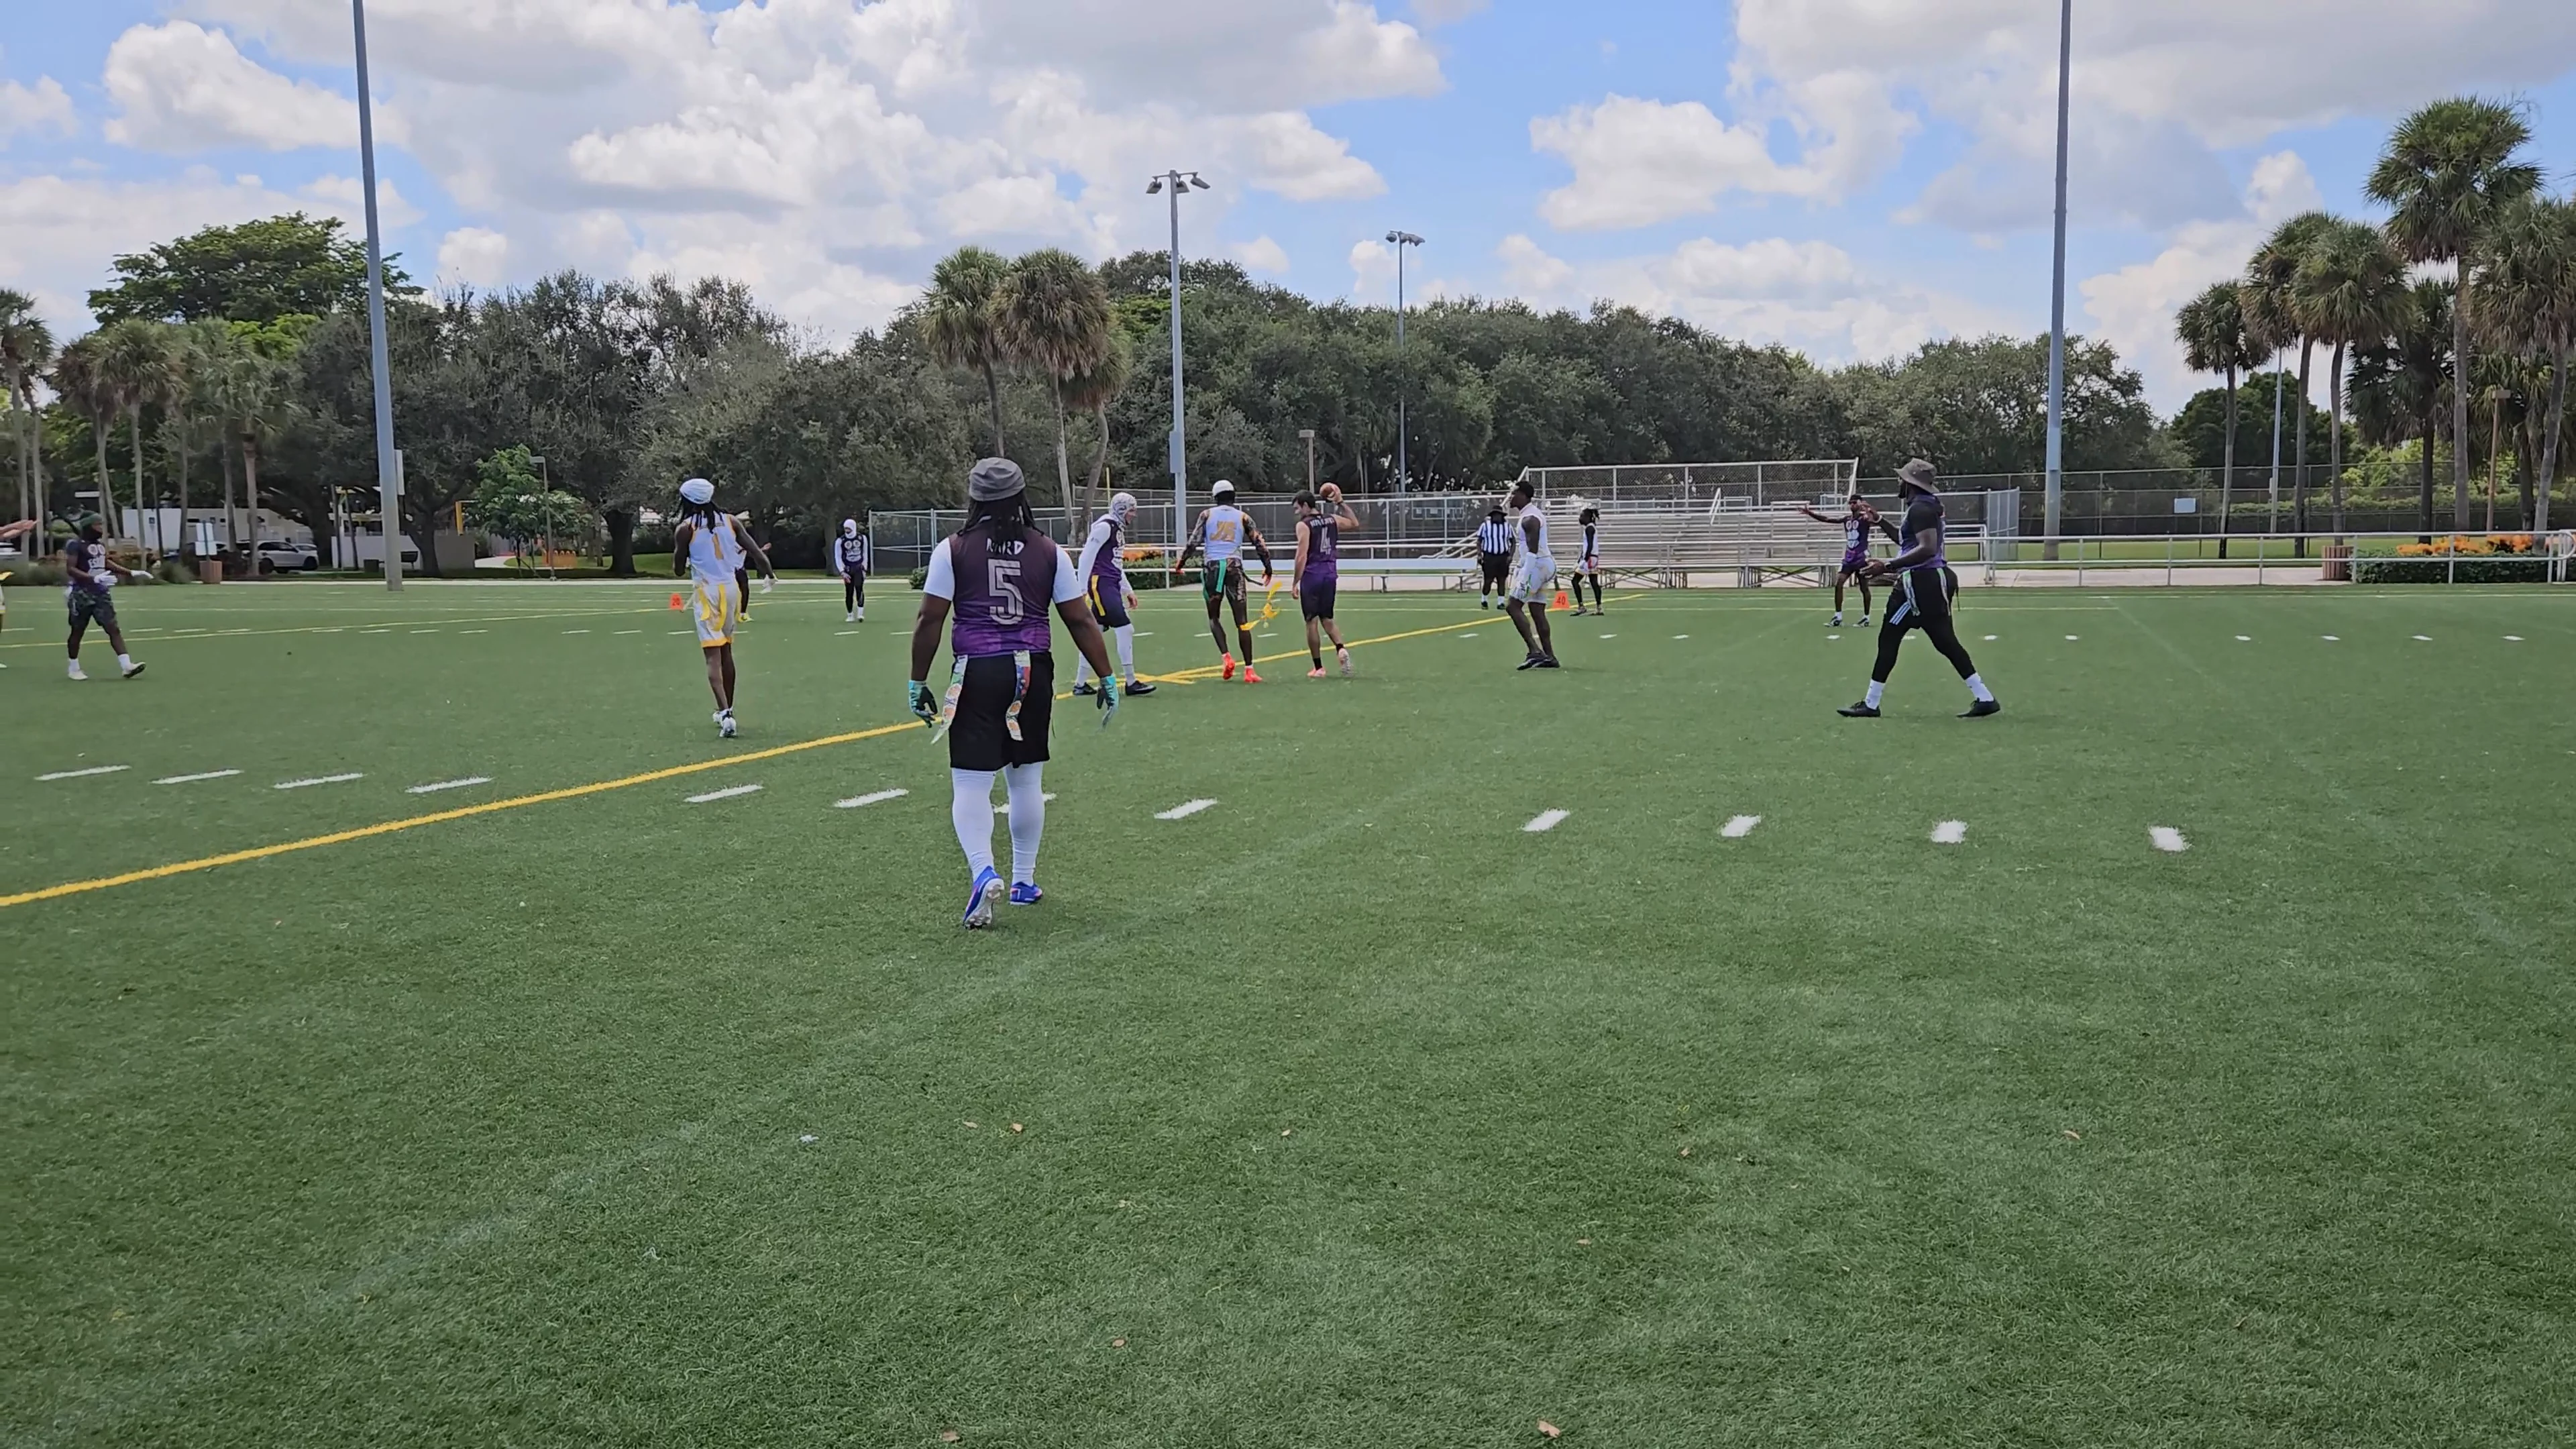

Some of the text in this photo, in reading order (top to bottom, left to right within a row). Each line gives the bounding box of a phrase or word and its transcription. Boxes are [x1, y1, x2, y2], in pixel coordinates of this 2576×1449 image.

[712, 533, 724, 560] 1
[1320, 526, 1332, 555] 4
[987, 558, 1024, 625] 5
[1555, 596, 1566, 605] 40
